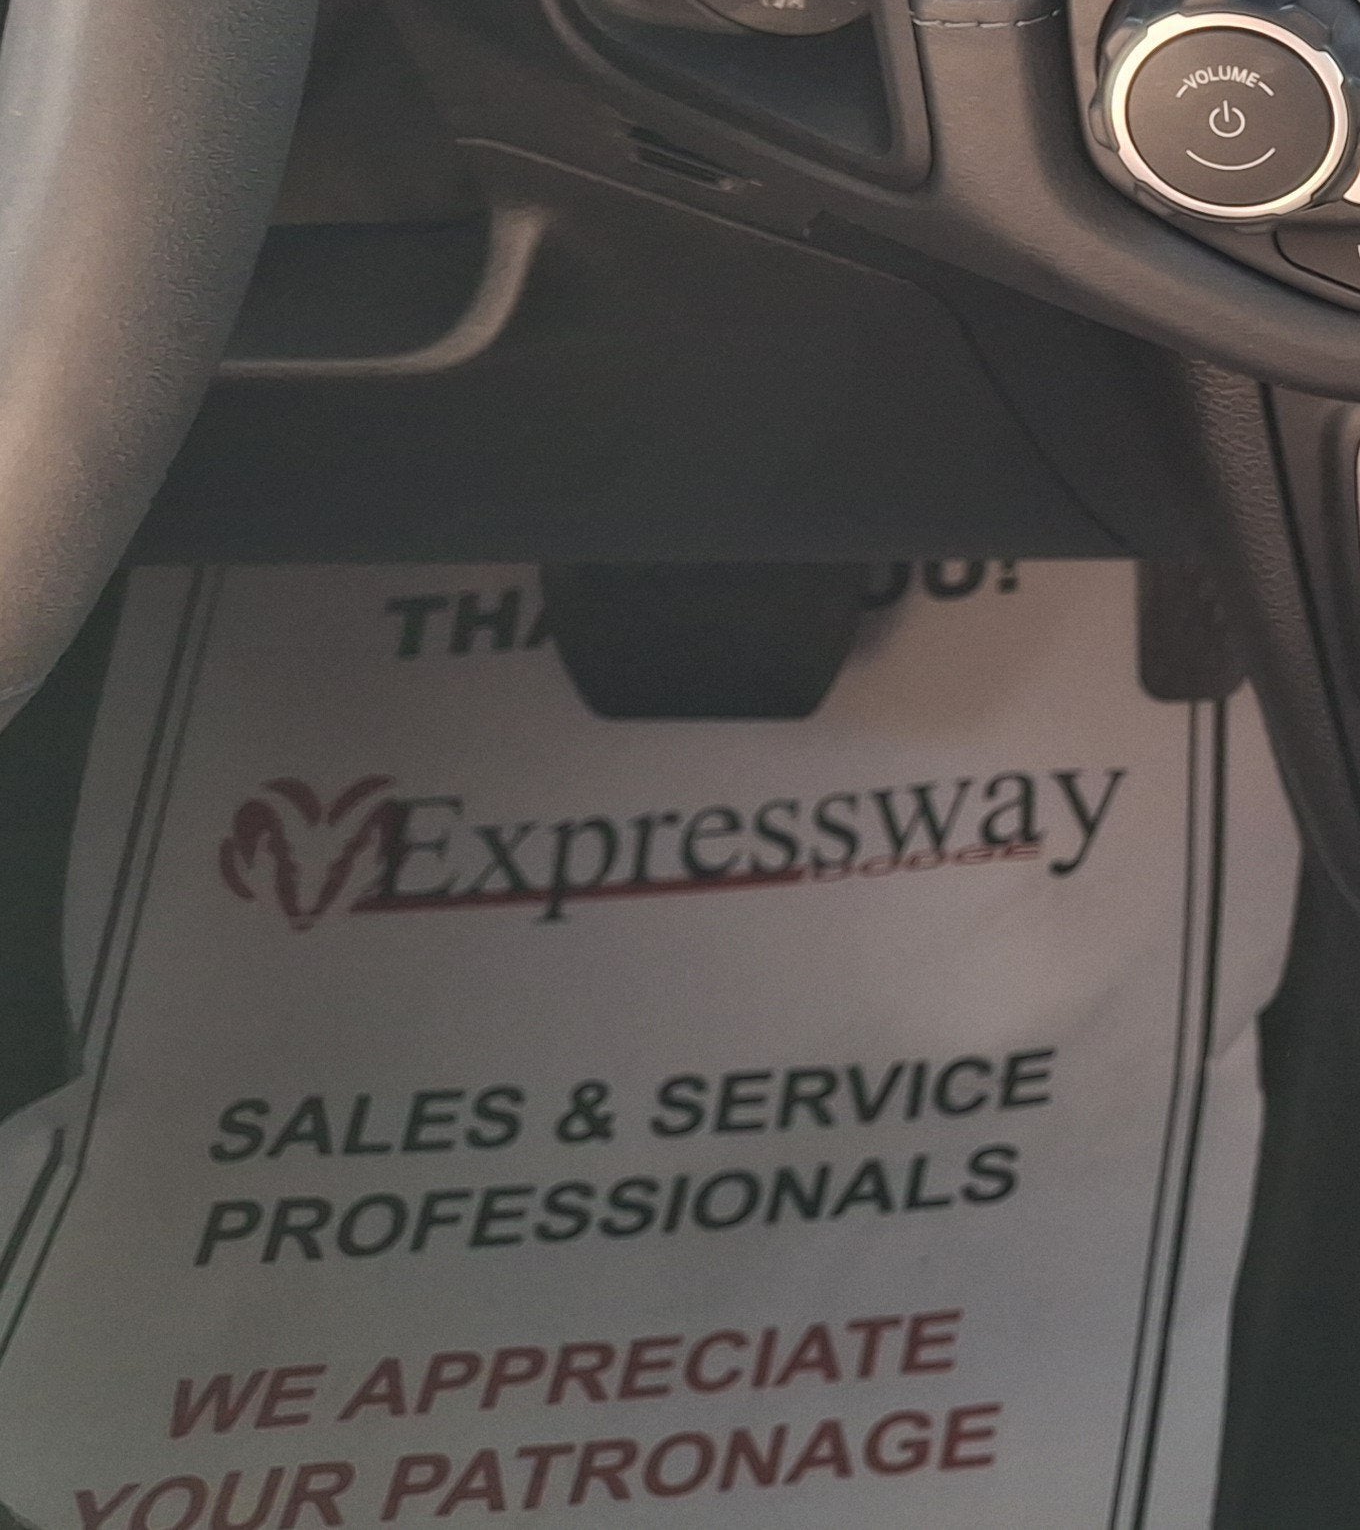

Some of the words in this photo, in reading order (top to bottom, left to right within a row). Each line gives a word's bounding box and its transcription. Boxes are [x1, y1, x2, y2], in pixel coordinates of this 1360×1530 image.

[1183, 67, 1260, 90] VOLUME
[372, 766, 1127, 925] Expressway
[210, 1084, 523, 1163] SALES
[556, 1080, 618, 1141] &
[650, 1049, 1056, 1140] SERVICE
[193, 1146, 1019, 1267] PROFESSIONALS
[168, 1364, 325, 1439] WE
[339, 1309, 963, 1422] APPRECIATE
[73, 1461, 355, 1530] YOUR
[383, 1404, 1001, 1520] PATRONAGE
